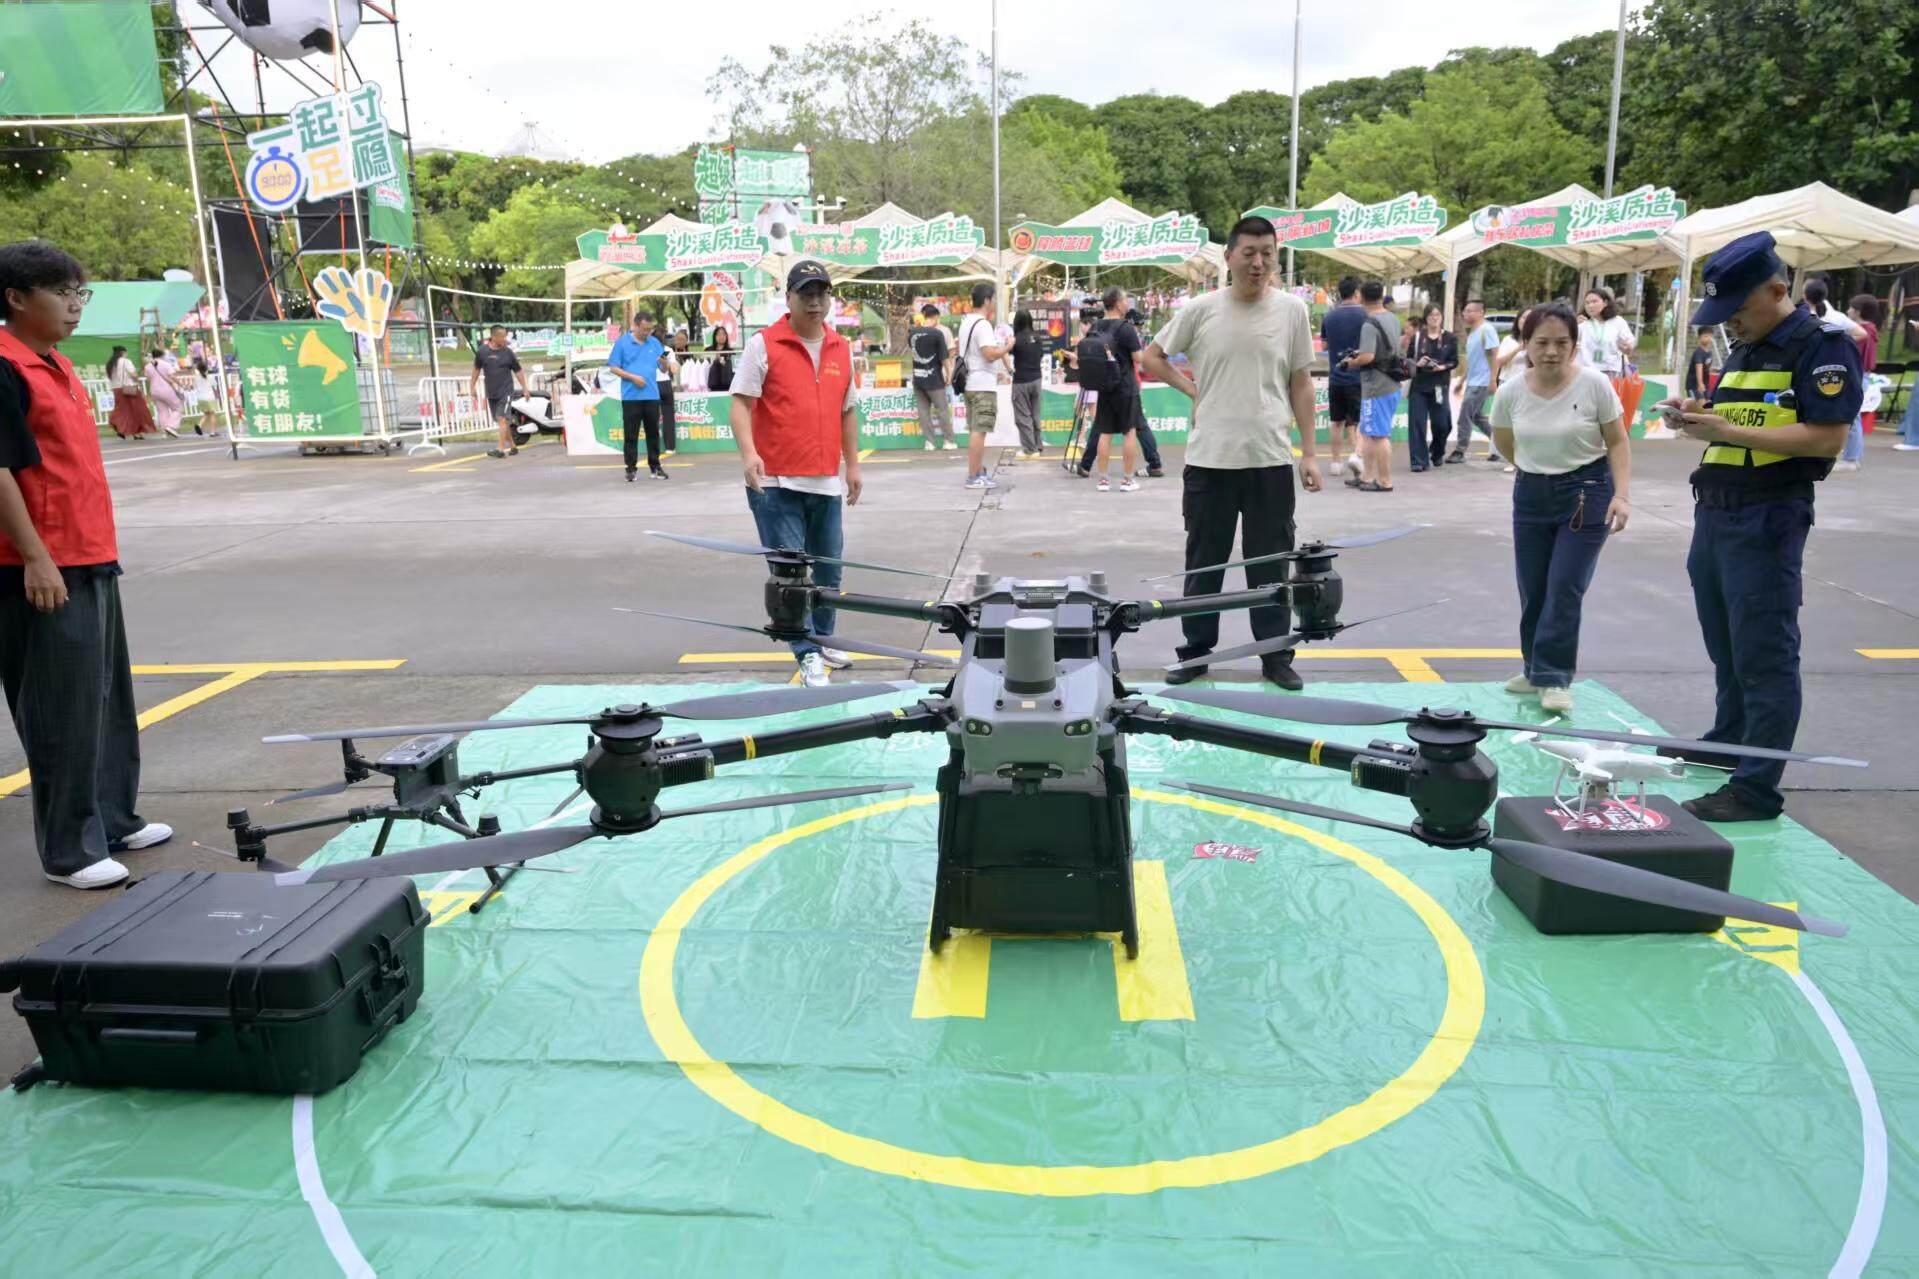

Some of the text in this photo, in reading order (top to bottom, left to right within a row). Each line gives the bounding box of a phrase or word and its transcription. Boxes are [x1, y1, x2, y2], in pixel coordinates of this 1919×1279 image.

[1339, 198, 1436, 233] 沙溪质造
[1572, 192, 1675, 228] 沙溪质造
[668, 226, 761, 257] 沙溪质造
[881, 218, 974, 250] 沙溪质造
[1102, 217, 1198, 249] 沙溪质造
[246, 365, 288, 386] 有球
